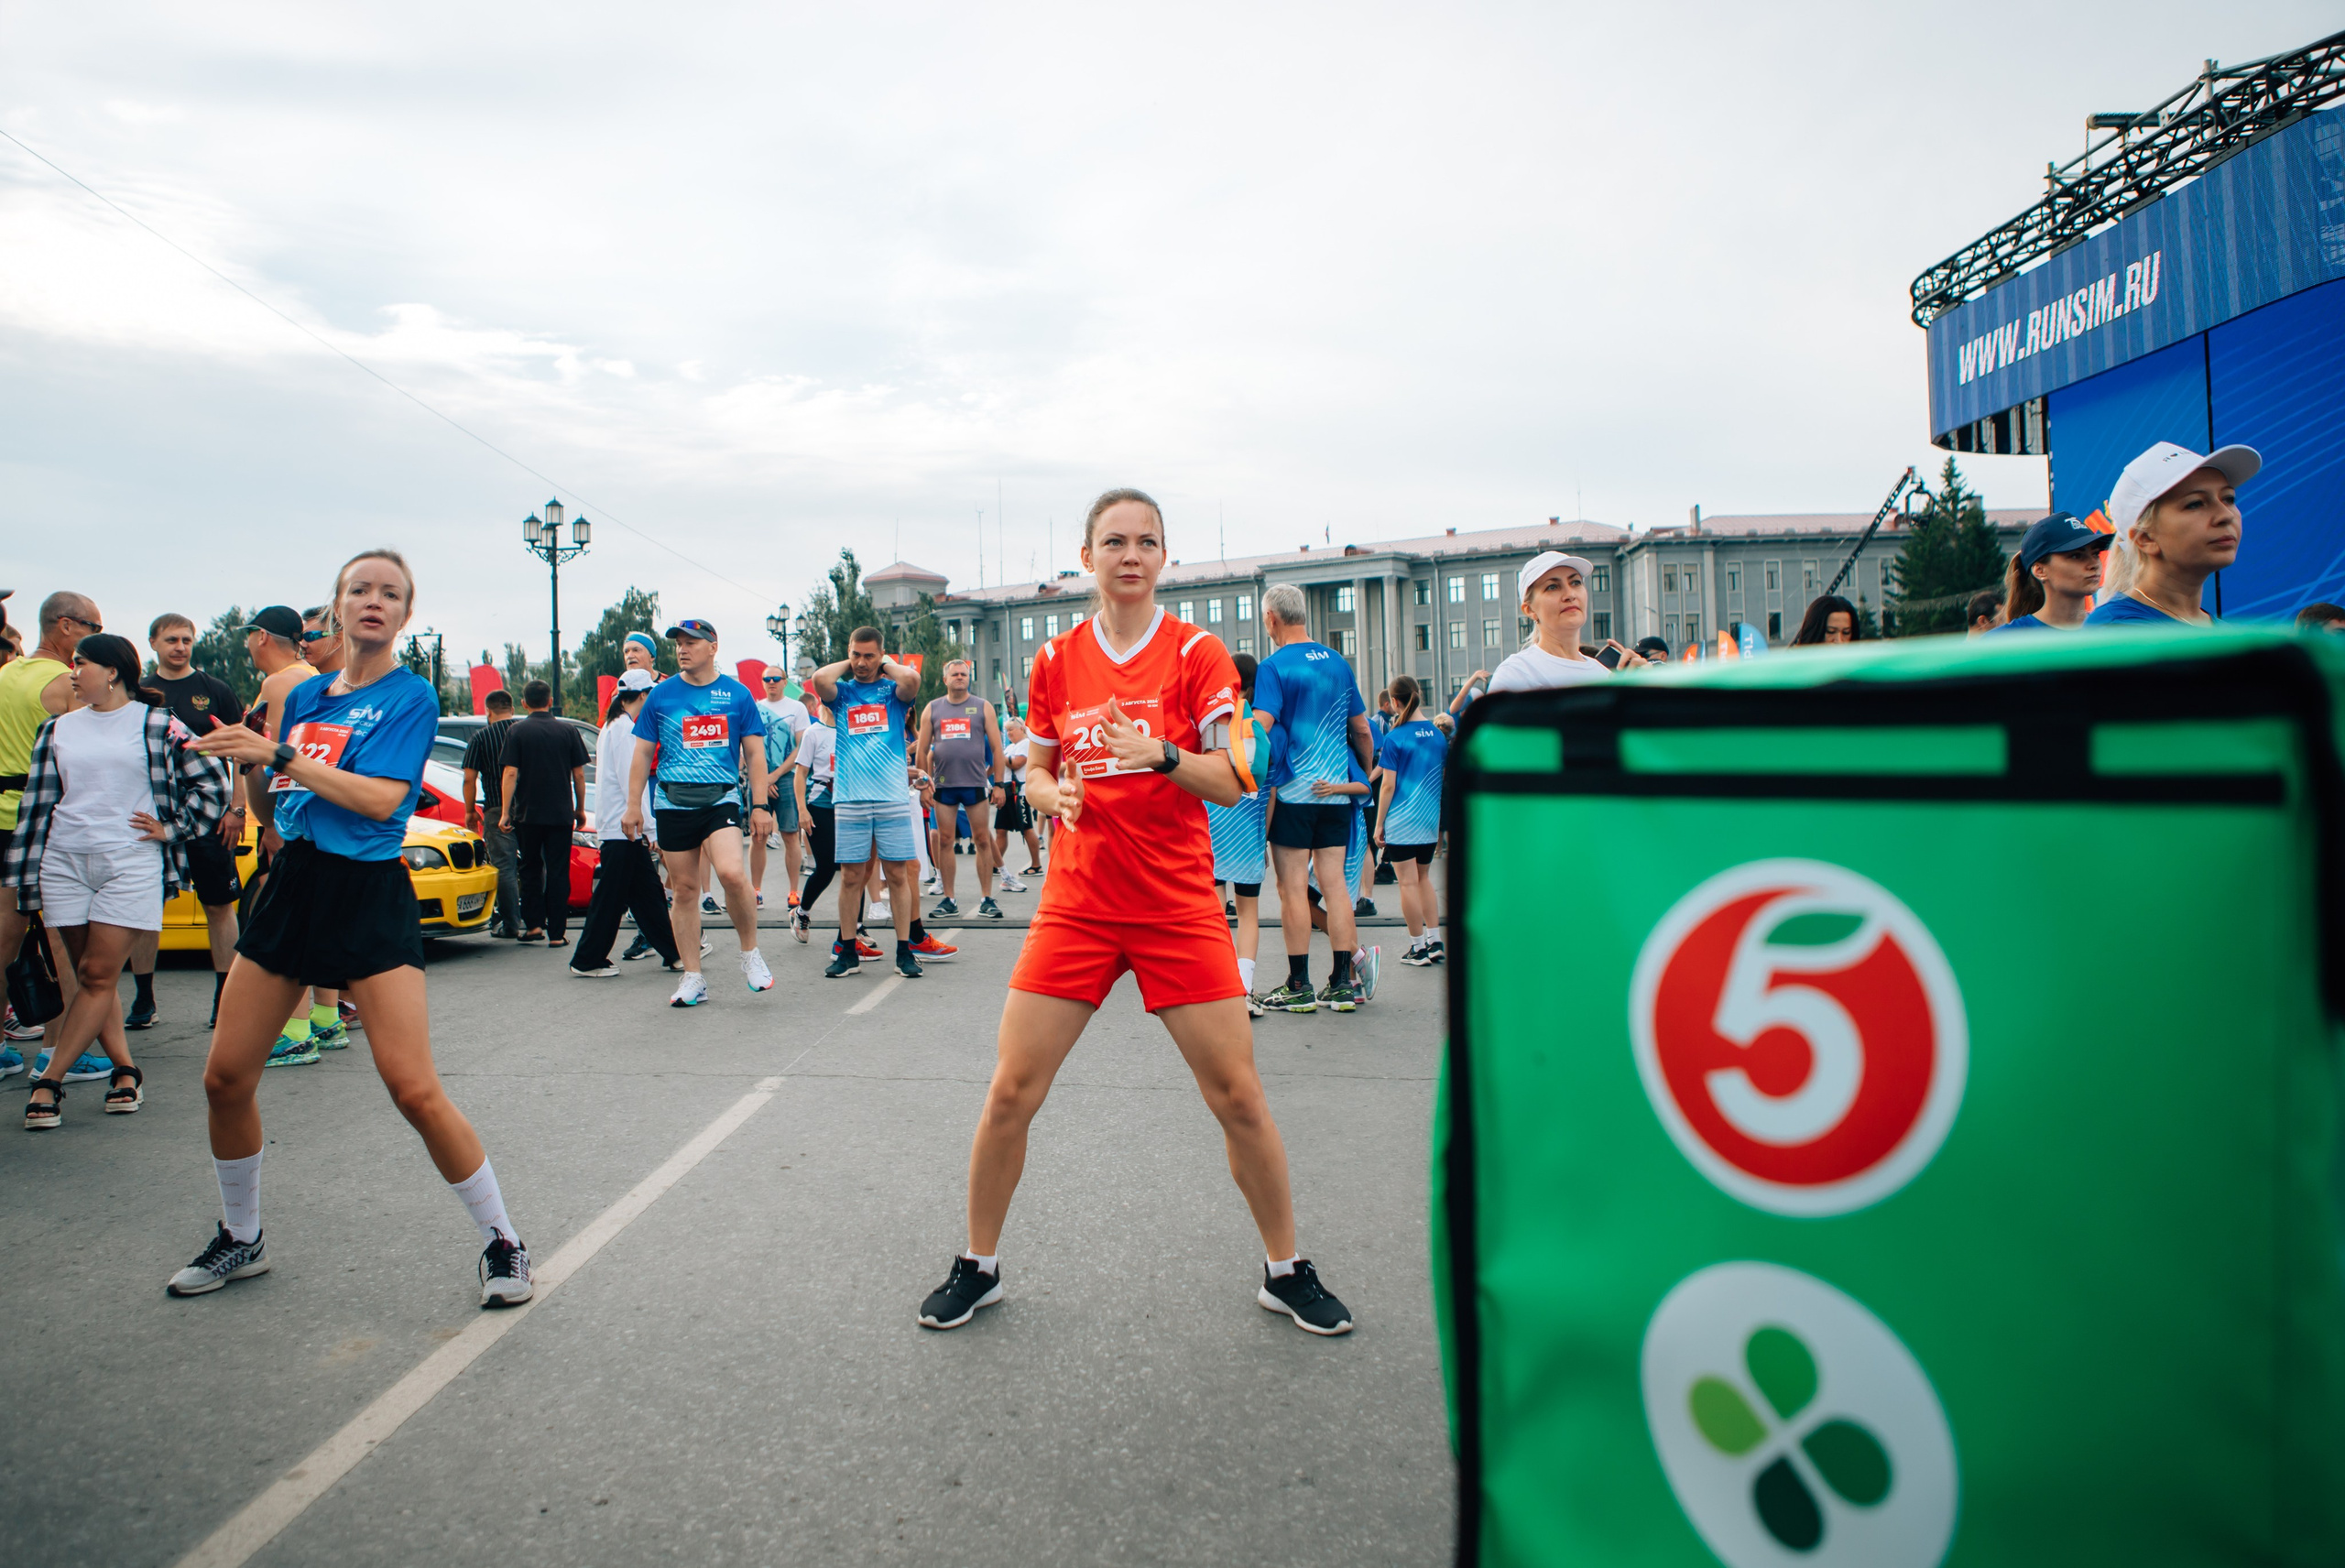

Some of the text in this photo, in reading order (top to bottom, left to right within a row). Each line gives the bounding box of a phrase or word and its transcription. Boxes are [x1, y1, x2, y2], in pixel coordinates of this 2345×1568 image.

[1958, 249, 2162, 387] WWW.RUNSIM.RU
[854, 712, 880, 724] 1861
[690, 724, 722, 737] 2491
[944, 724, 966, 732] 2186
[1703, 898, 1878, 1149] 5
